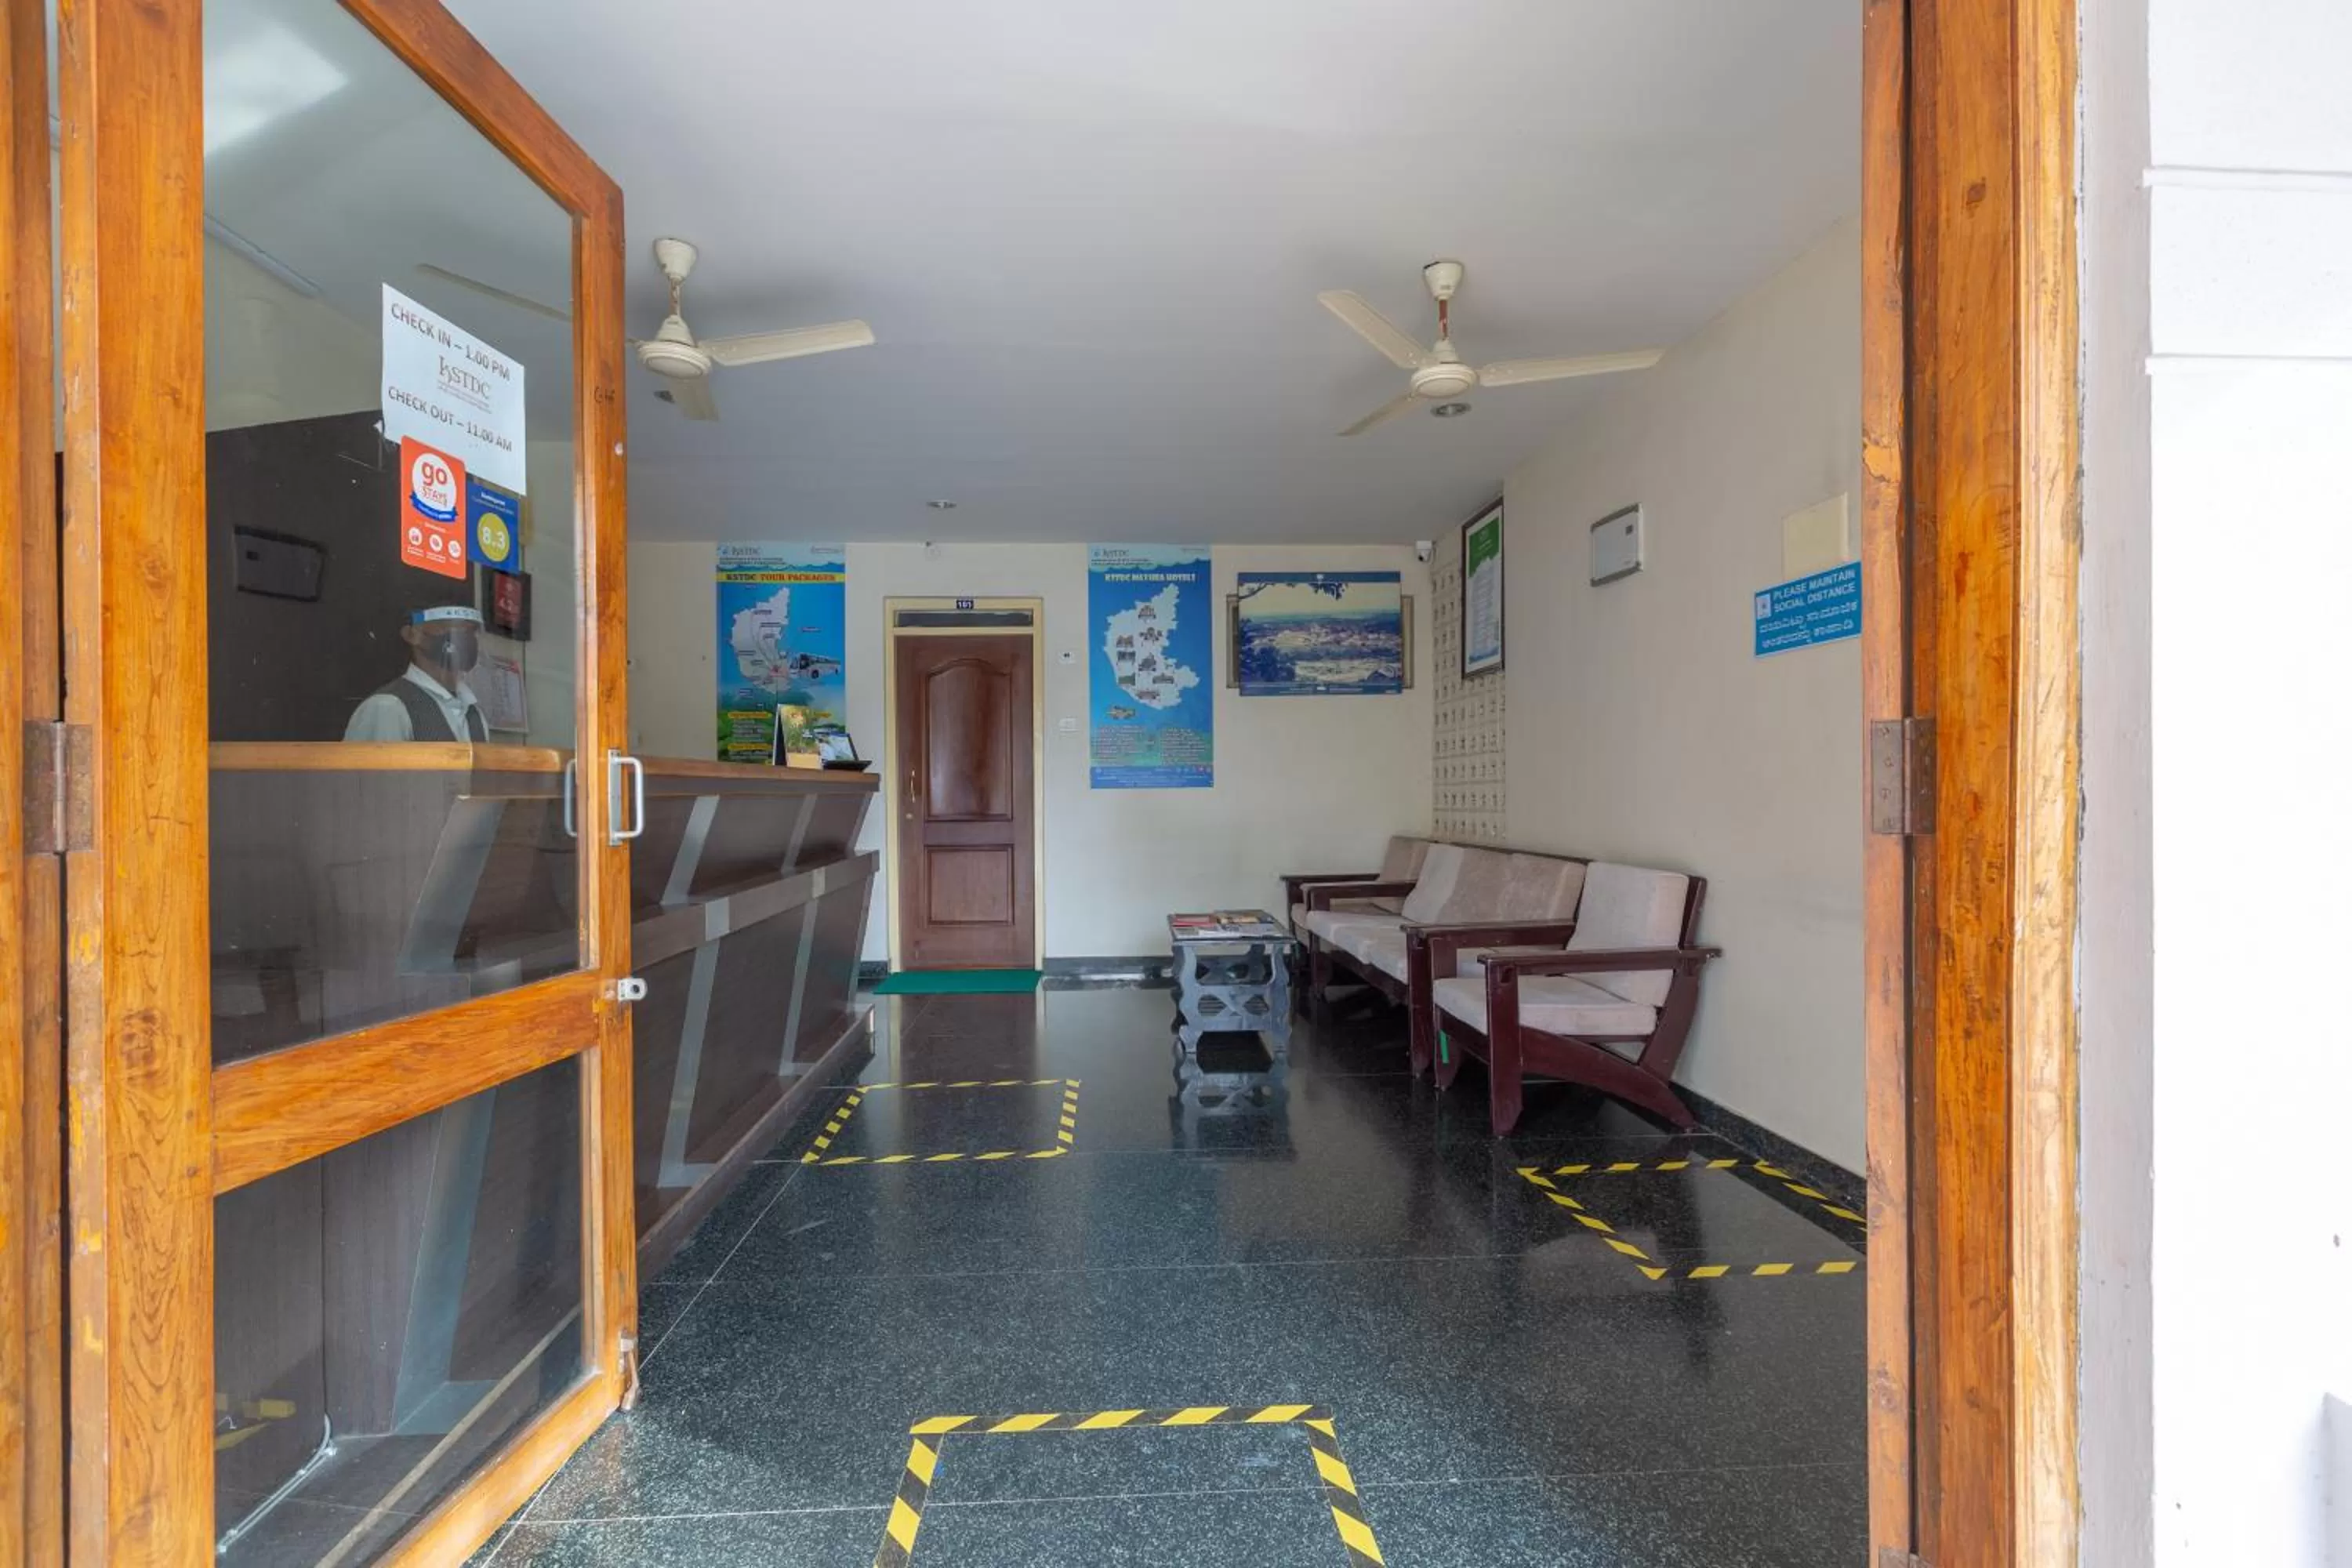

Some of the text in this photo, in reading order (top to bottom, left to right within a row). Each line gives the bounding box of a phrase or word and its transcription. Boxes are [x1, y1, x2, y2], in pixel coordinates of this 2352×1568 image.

[391, 303, 434, 339] CHECK
[438, 328, 451, 349] IN
[466, 344, 490, 369] 1.00
[492, 361, 510, 381] PM
[388, 386, 427, 414] CHECK
[430, 405, 453, 426] OUT
[466, 421, 493, 444] 11.00
[496, 436, 512, 452] AM
[421, 462, 448, 486] go
[482, 526, 506, 550] 8.3
[1773, 569, 1856, 601] PLEASE MAINTAIN
[1773, 583, 1856, 612] SOCIAL DISTANCE
